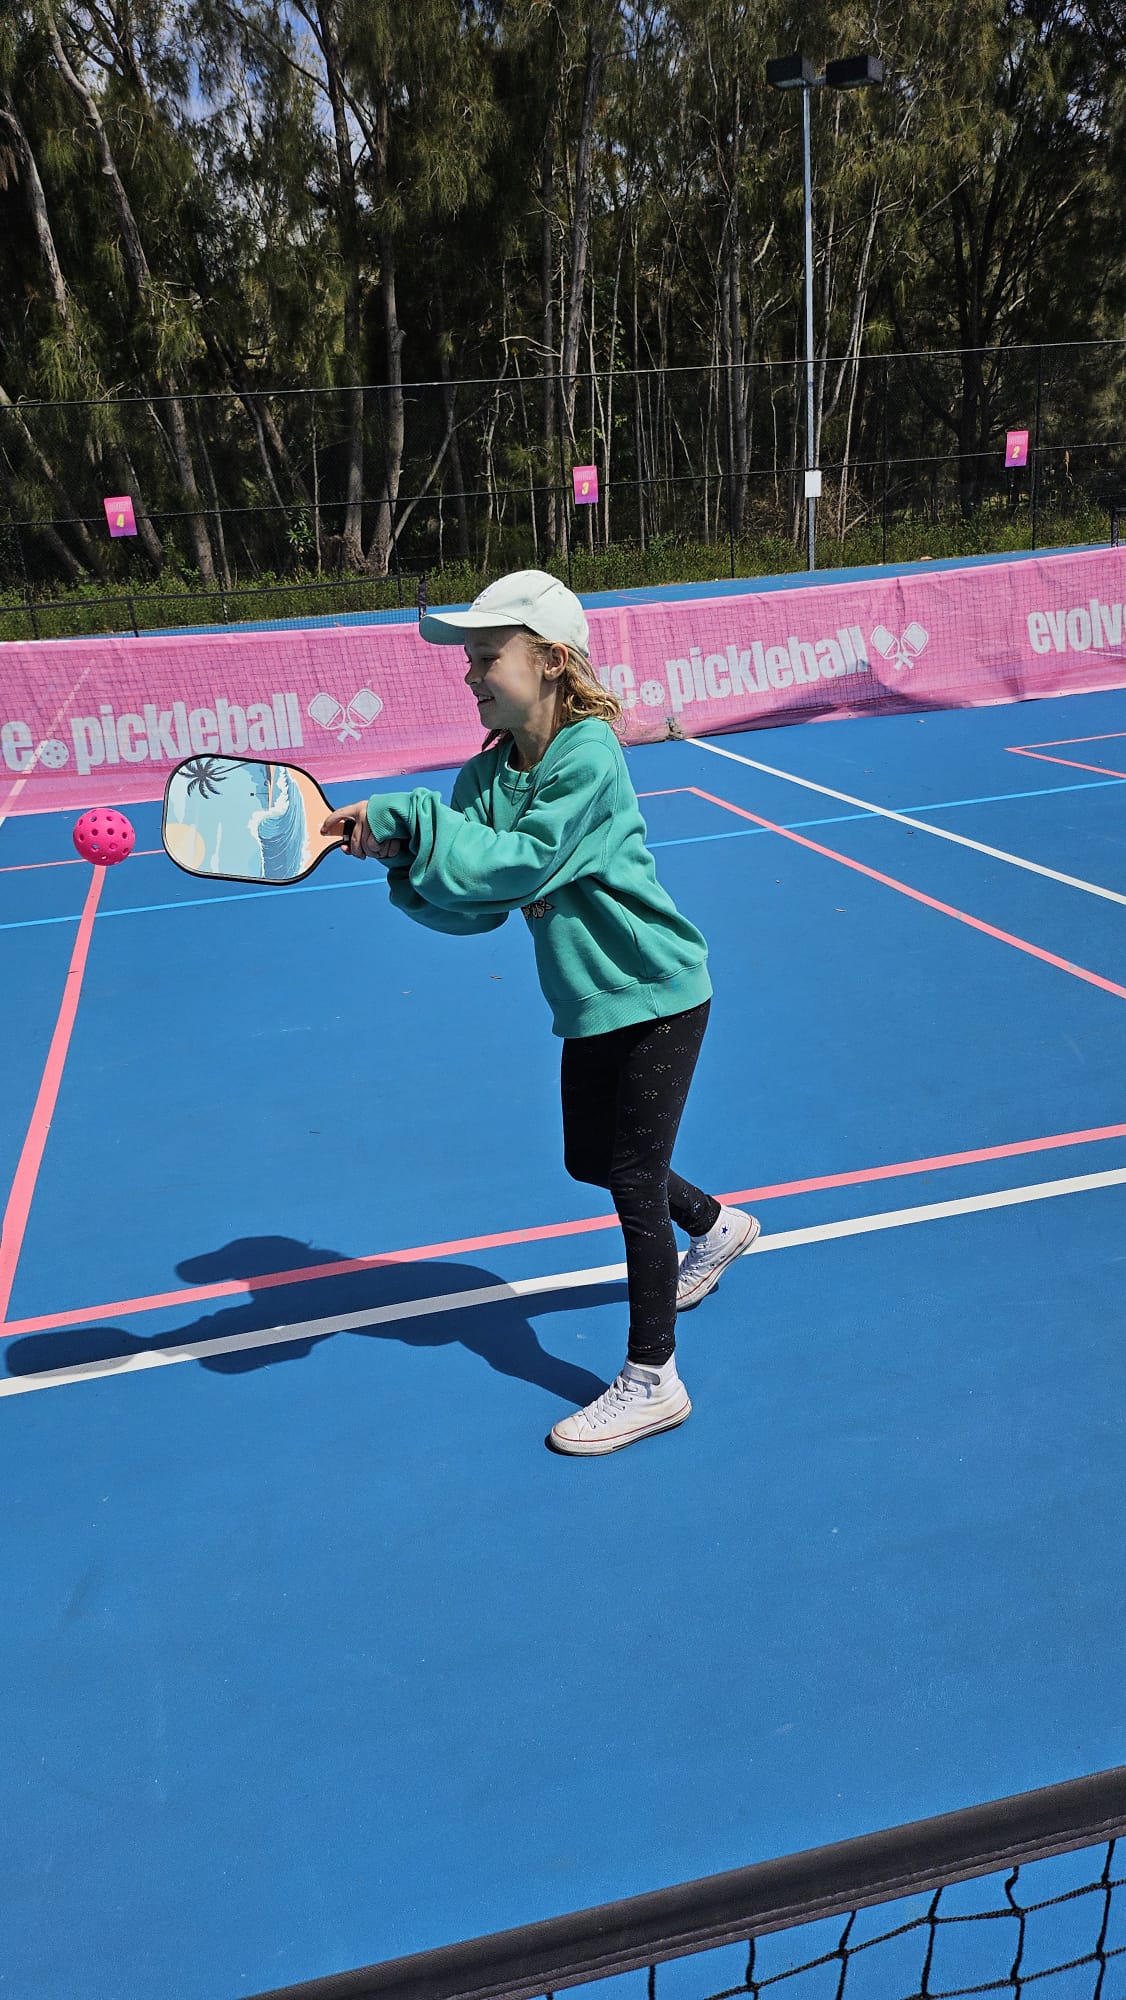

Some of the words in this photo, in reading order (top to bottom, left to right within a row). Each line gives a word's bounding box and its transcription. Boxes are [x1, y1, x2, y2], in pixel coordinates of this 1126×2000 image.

[1011, 445, 1021, 459] 2
[581, 481, 590, 496] 3
[115, 513, 125, 528] 4
[1027, 598, 1126, 654] evolv
[665, 625, 869, 713] pickleball
[70, 692, 304, 776] pickleball
